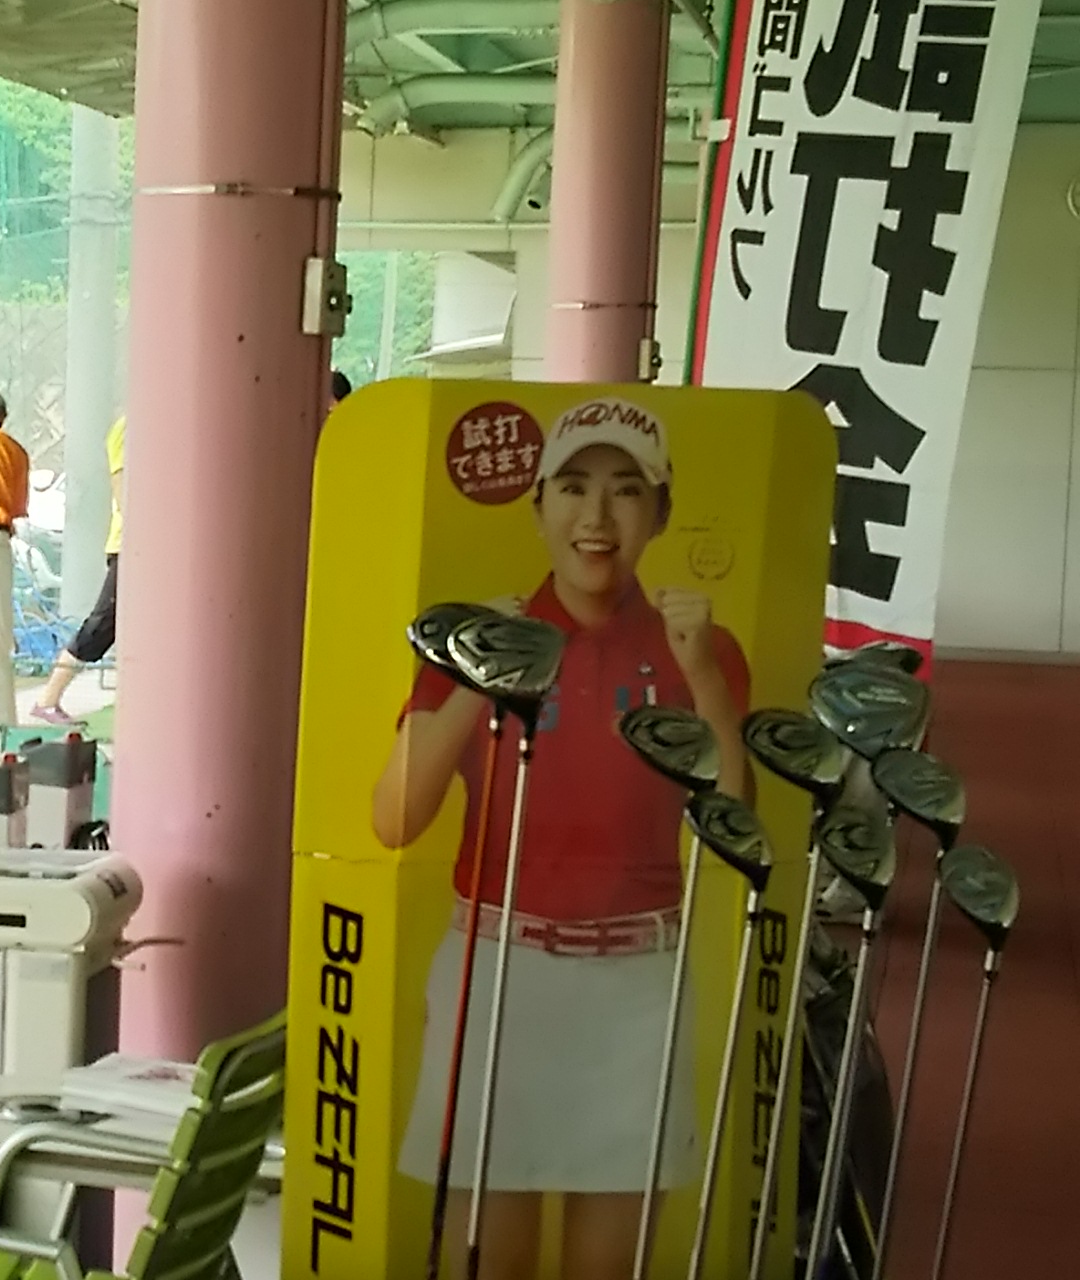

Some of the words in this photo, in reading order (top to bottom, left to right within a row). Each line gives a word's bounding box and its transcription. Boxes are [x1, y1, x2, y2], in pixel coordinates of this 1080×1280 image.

[461, 414, 523, 450] 試打
[557, 402, 660, 448] HONMA
[450, 442, 540, 480] できます
[320, 902, 363, 1016] Be
[310, 1025, 359, 1276] ZEAL
